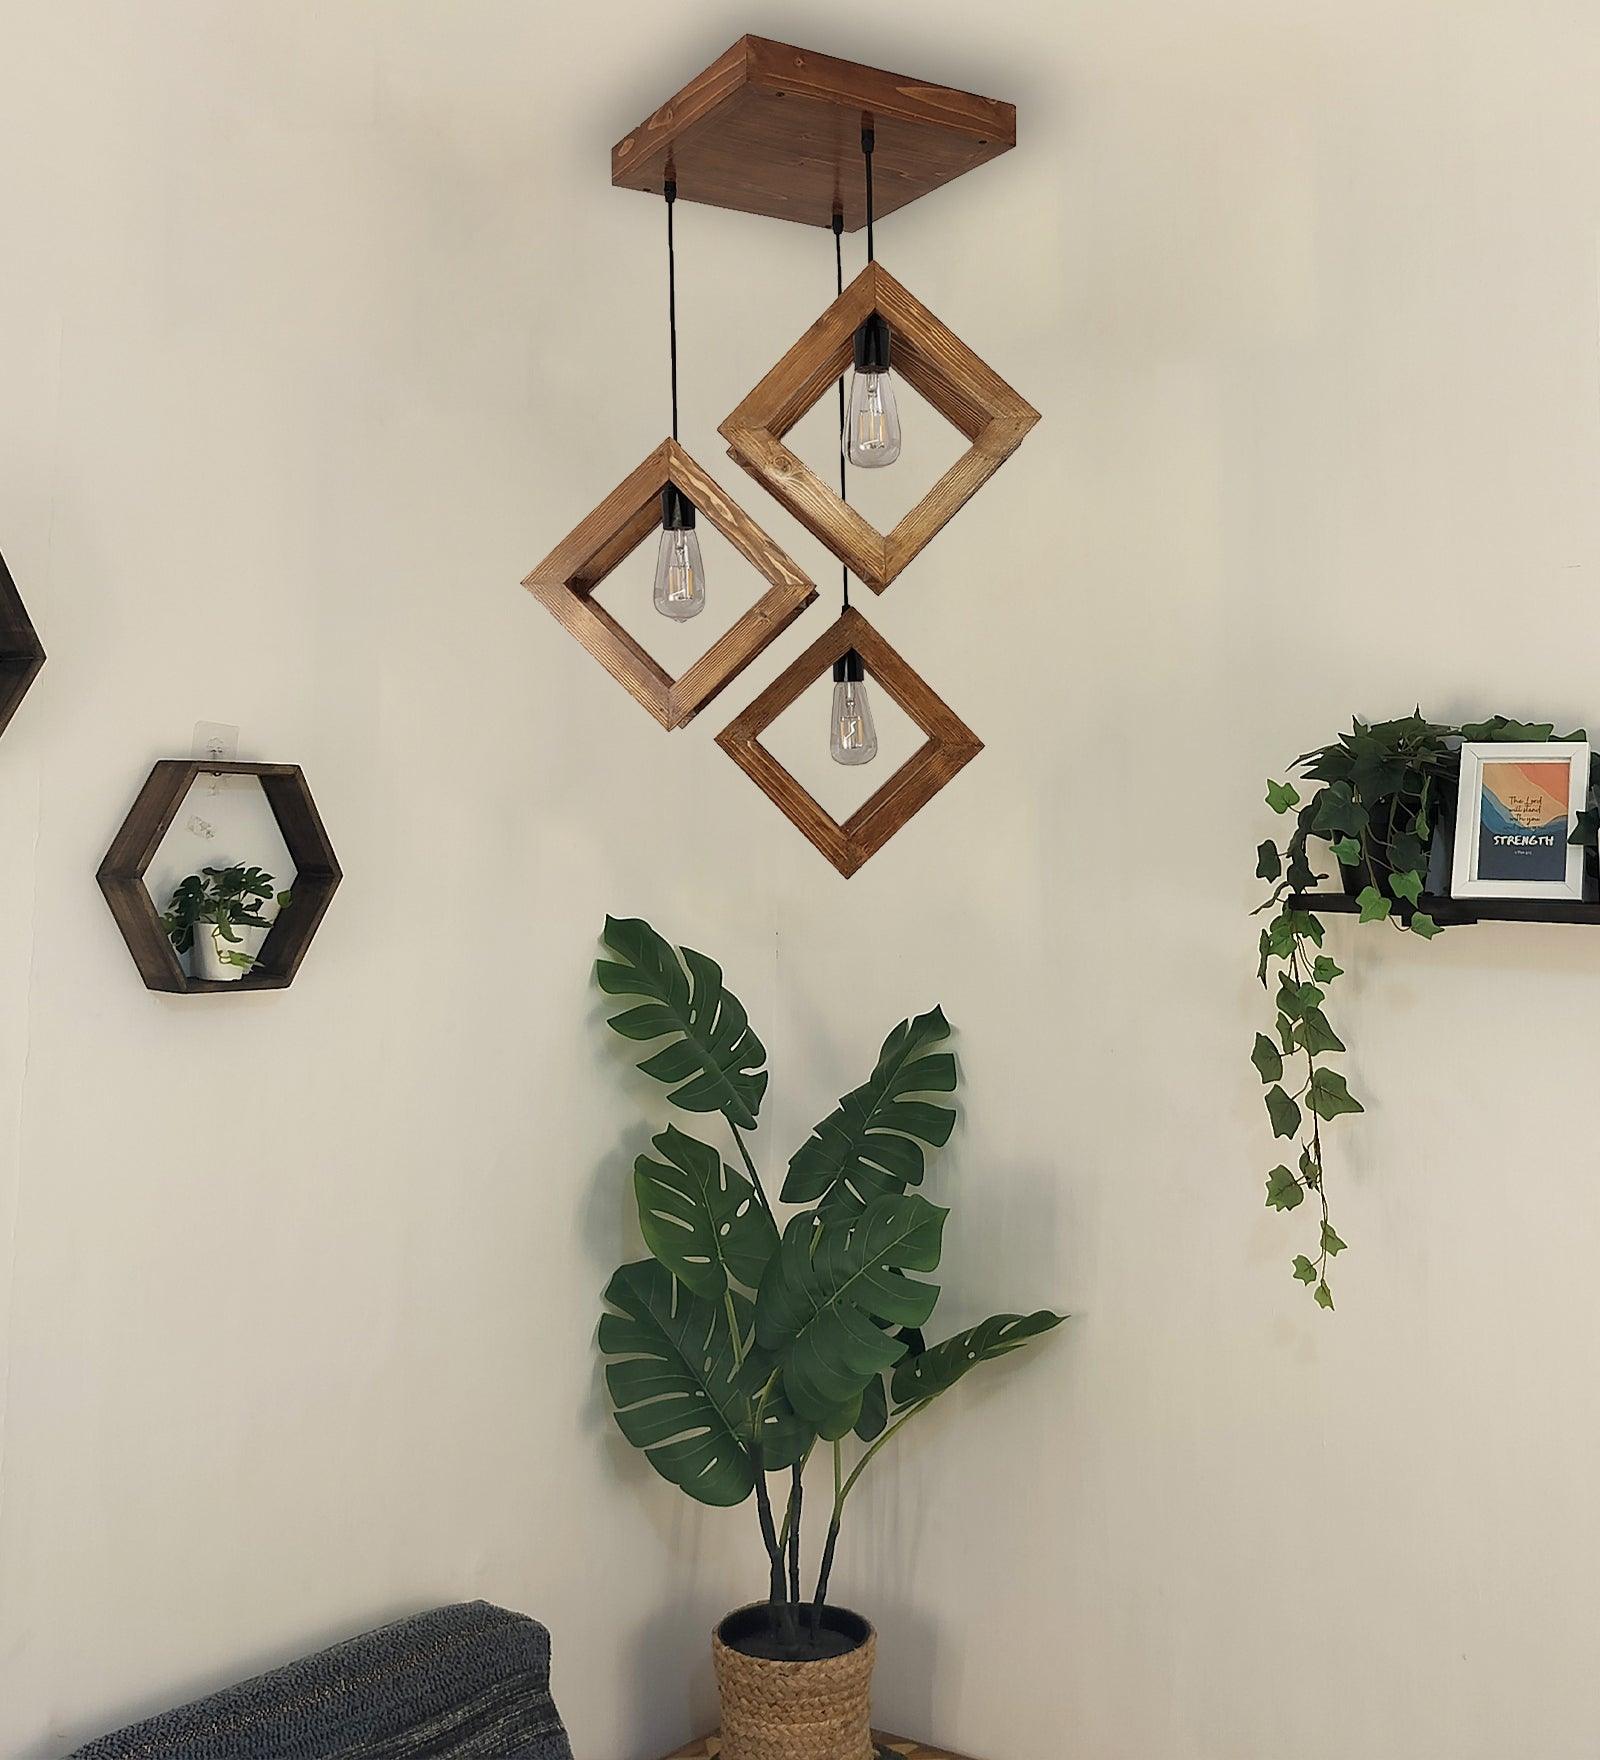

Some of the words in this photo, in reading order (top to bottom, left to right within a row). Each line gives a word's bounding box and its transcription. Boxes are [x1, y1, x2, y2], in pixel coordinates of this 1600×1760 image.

[1509, 796, 1523, 805] The
[1524, 796, 1542, 805] Lord
[1523, 805, 1541, 813] stand
[1493, 835, 1554, 846] STRENGTH
